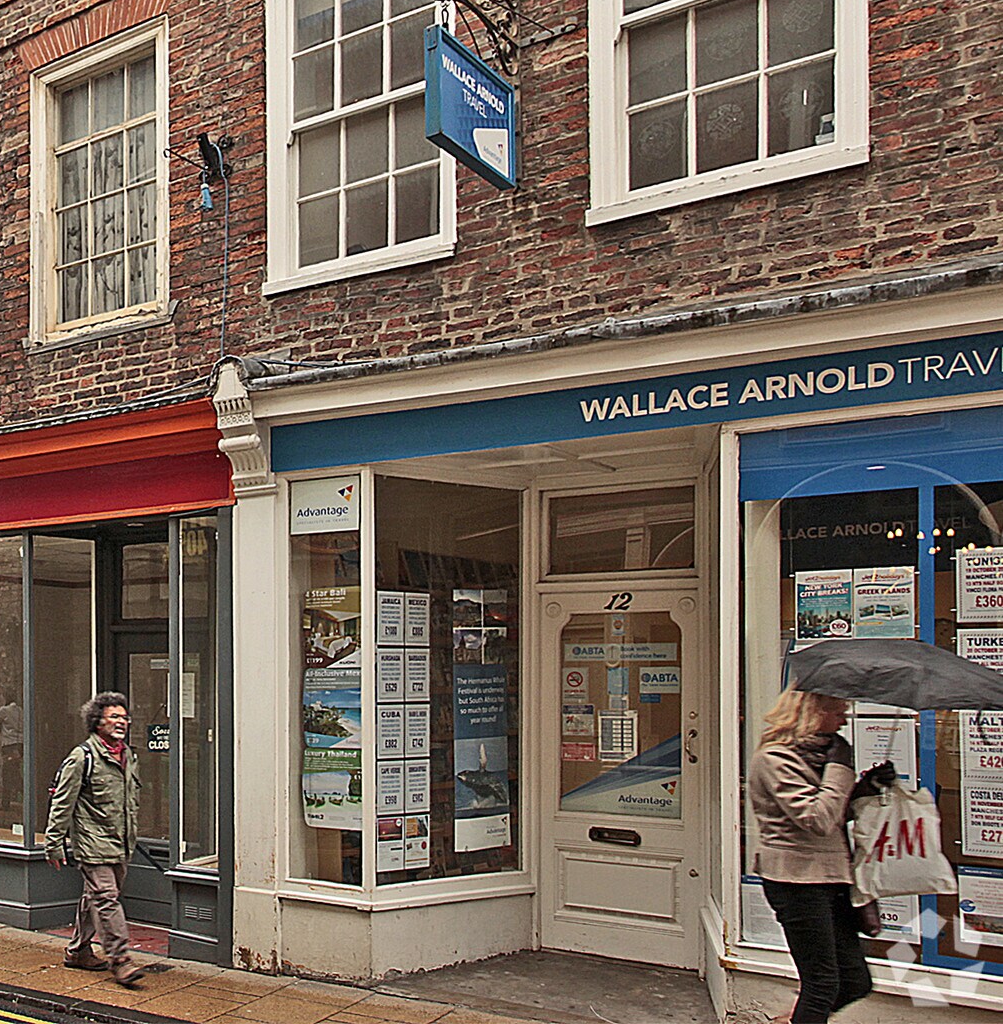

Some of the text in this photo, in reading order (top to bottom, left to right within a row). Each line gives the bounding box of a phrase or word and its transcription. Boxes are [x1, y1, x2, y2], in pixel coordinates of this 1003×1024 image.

[441, 53, 505, 115] WALLACE ARNOLD
[462, 88, 488, 119] TRAVEL
[579, 346, 1003, 422] WALLACE ARNOLD TRAV
[296, 506, 349, 518] Advantage
[832, 521, 907, 537] ARNOLD
[823, 581, 843, 589] YORK
[311, 589, 328, 597] Star
[329, 588, 347, 596] Bali
[799, 587, 849, 598] CITY BREAKS!
[603, 591, 633, 611] 12
[975, 594, 1003, 608] £360
[580, 646, 606, 655] ABTA
[305, 669, 344, 677] All-Inclusive
[650, 672, 679, 683] ABTA
[456, 677, 467, 685] The
[457, 687, 477, 695] Festival
[458, 697, 468, 705] but
[468, 696, 484, 704] South
[470, 715, 497, 725] year round
[148, 740, 170, 750] CLOS
[304, 749, 358, 758] Luxury Thailand
[970, 790, 992, 800] COSTA
[618, 794, 673, 807] Advantage
[879, 912, 898, 921] 430
